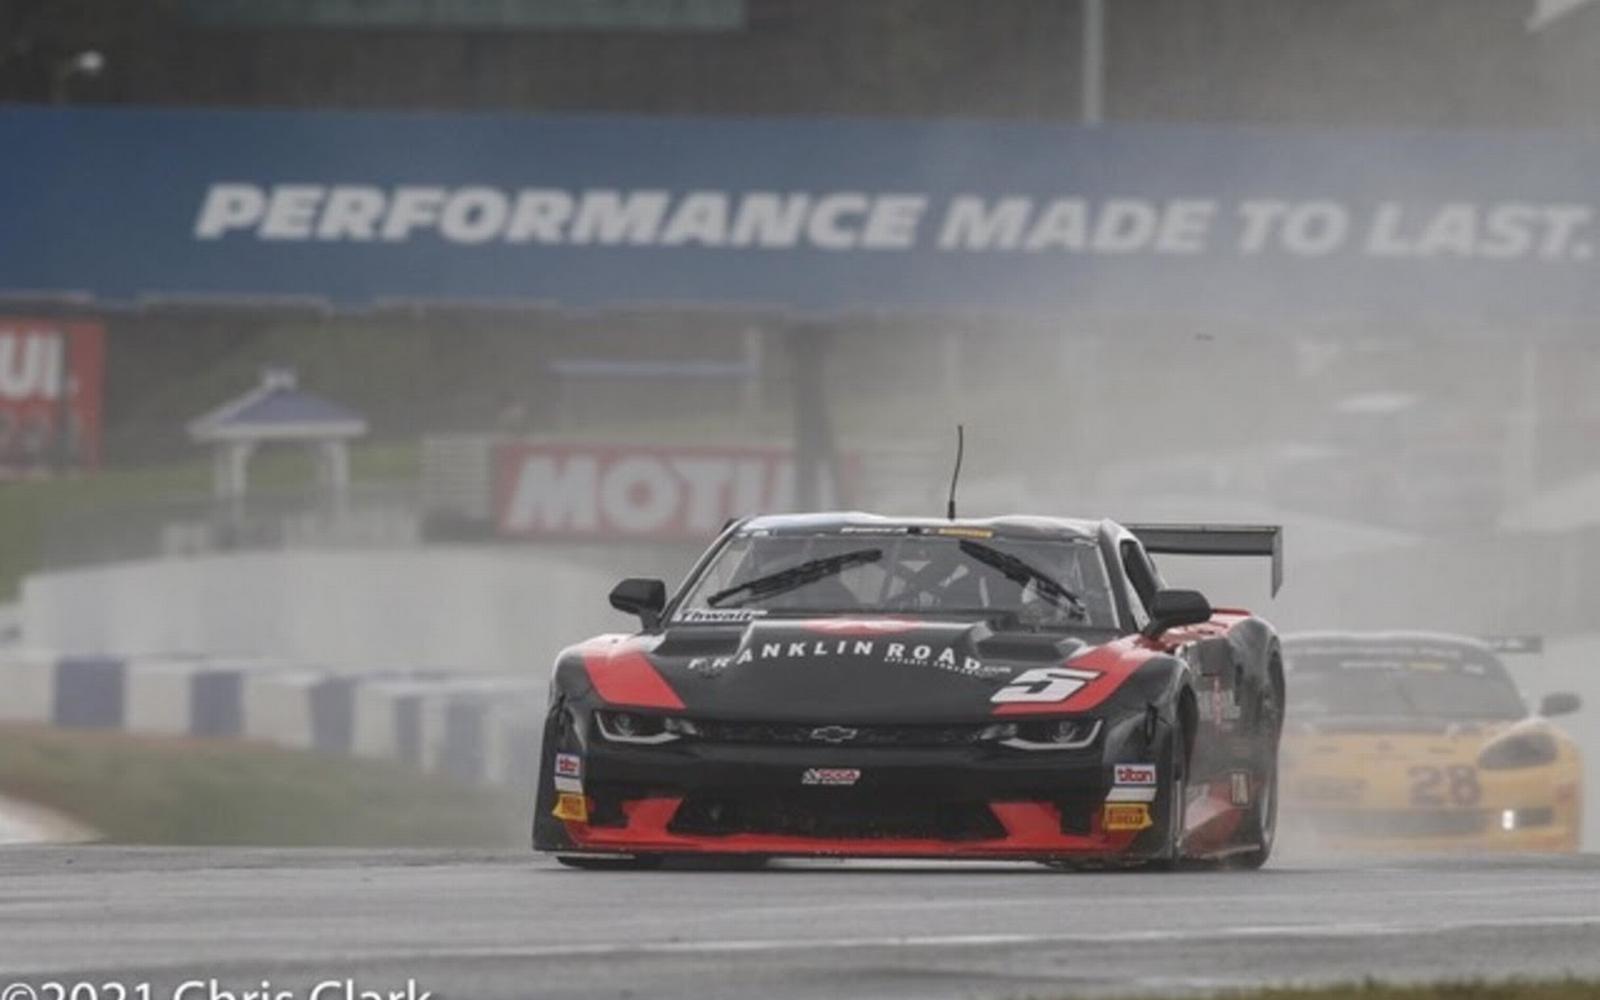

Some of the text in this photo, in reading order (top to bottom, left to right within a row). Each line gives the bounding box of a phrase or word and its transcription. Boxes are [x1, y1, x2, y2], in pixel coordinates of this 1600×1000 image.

[195, 183, 1594, 259] PERFORMANCE MADE TO LAST.
[687, 640, 874, 669] FRANKLIN
[886, 642, 982, 672] ROAD
[989, 668, 1100, 702] 5
[1407, 764, 1481, 809] 28
